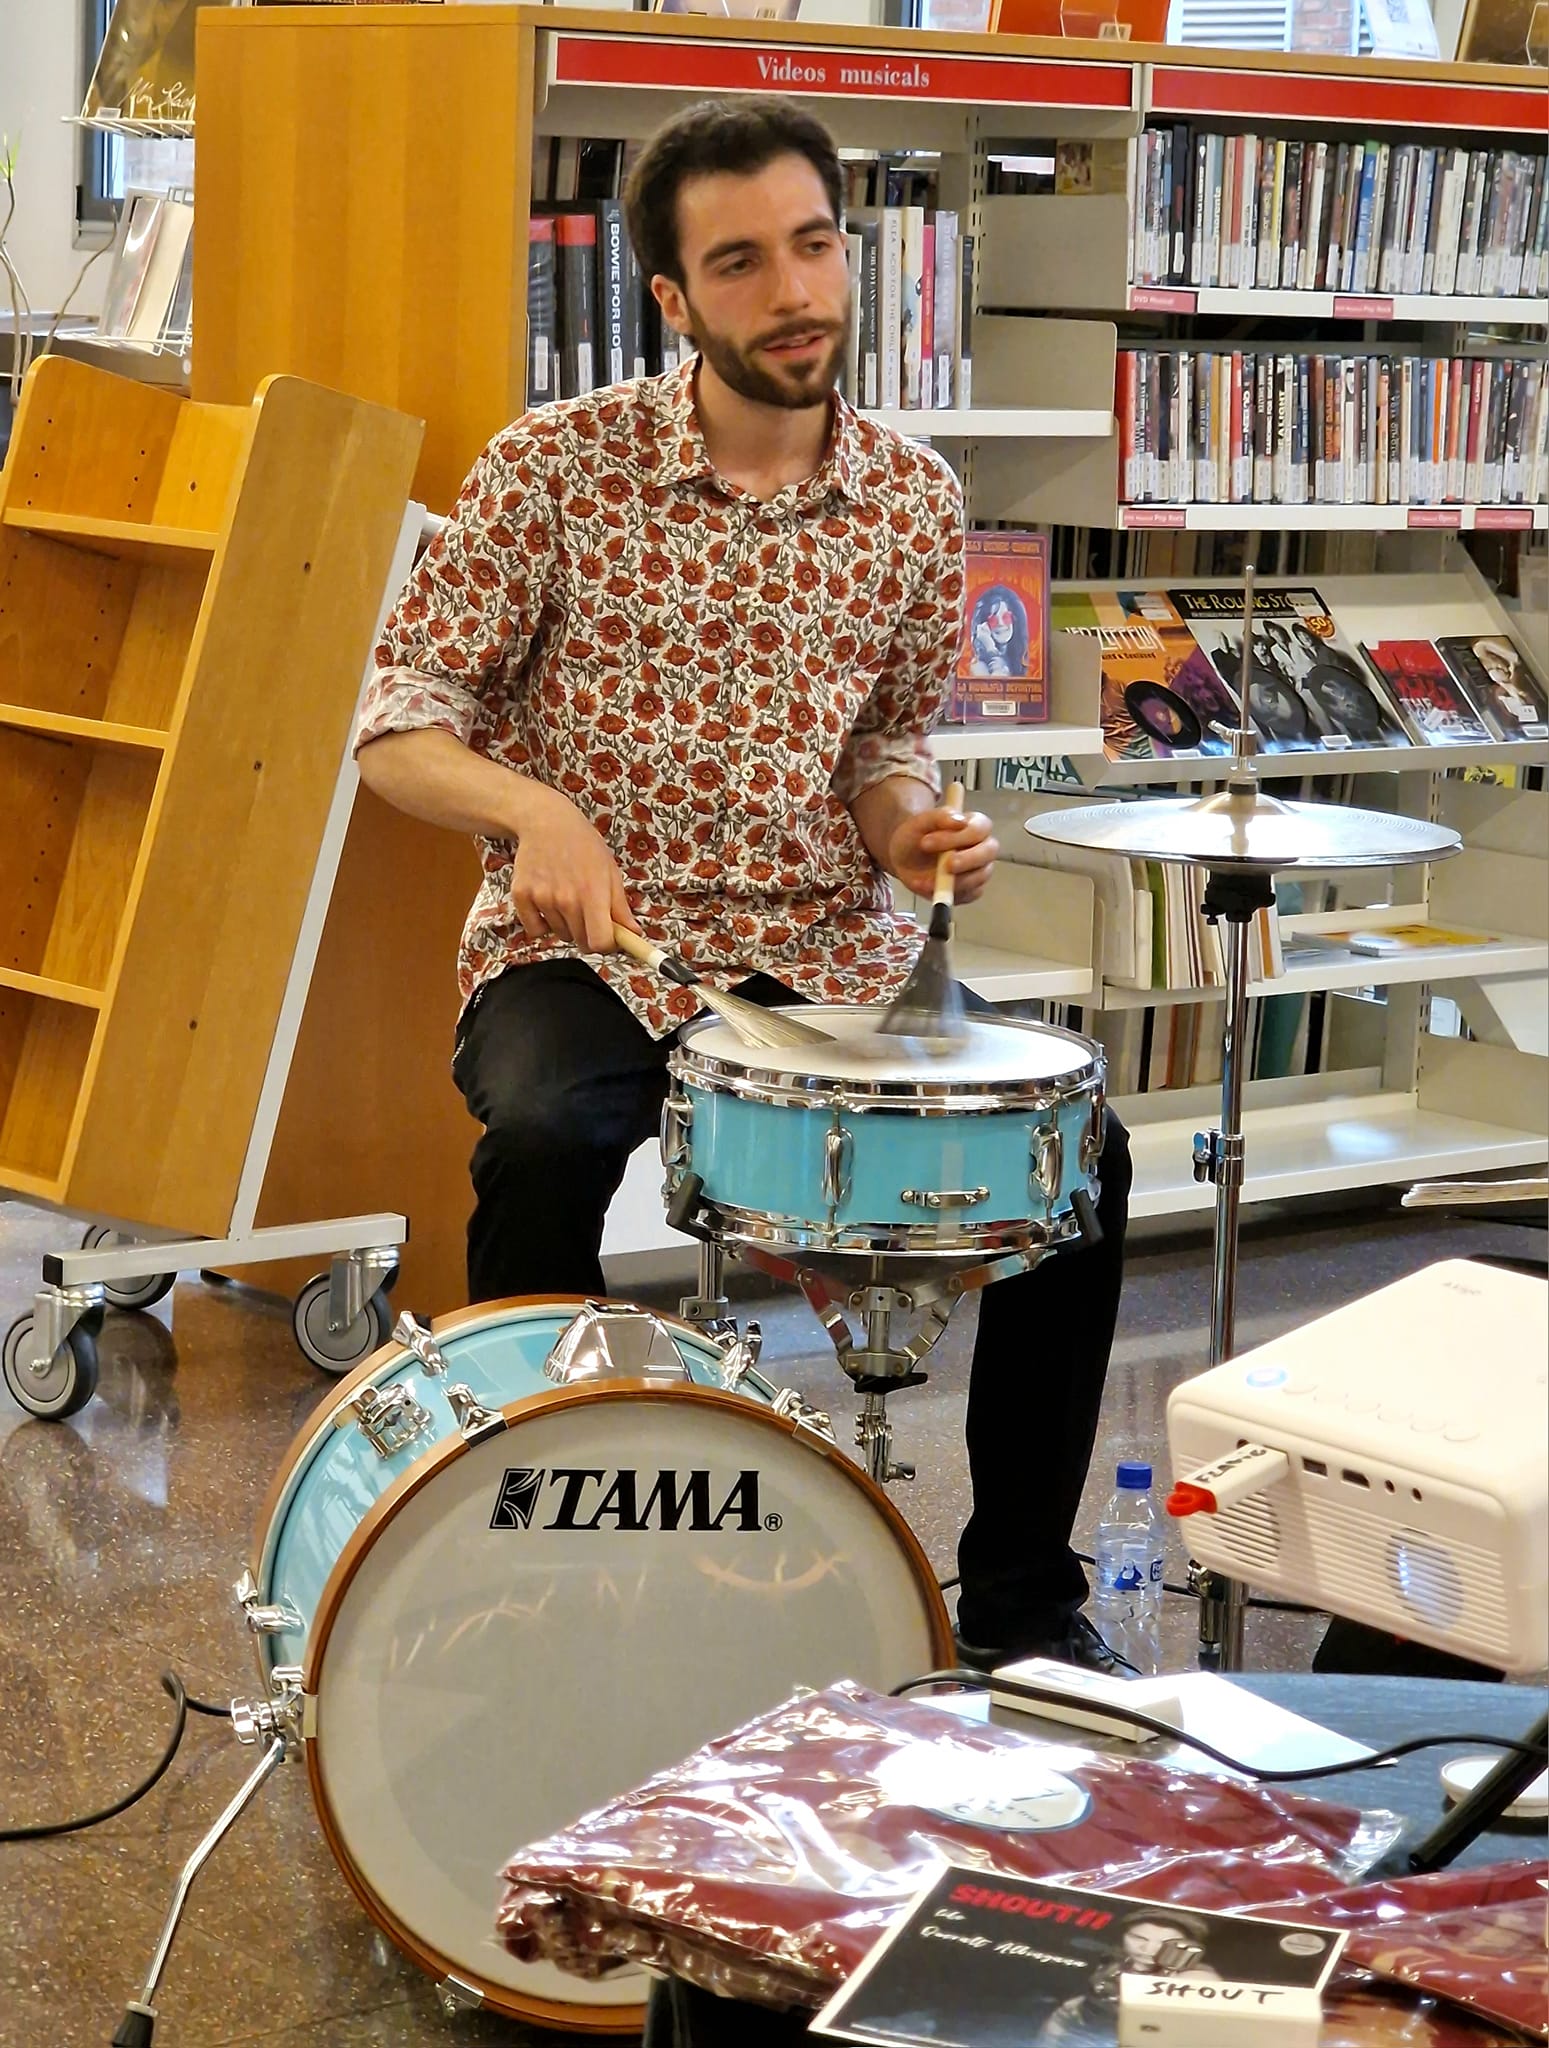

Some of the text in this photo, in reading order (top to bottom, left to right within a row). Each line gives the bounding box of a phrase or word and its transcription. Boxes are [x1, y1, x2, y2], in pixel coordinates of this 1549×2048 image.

[757, 56, 930, 89] Videos musicals
[610, 223, 621, 281] BOWIE
[611, 284, 622, 320] POR
[1242, 390, 1251, 434] QUEEN
[1179, 594, 1211, 609] THE
[1209, 594, 1270, 609] ROLLNG
[1310, 616, 1326, 630] 50
[1146, 1981, 1285, 2005] SHOUT
